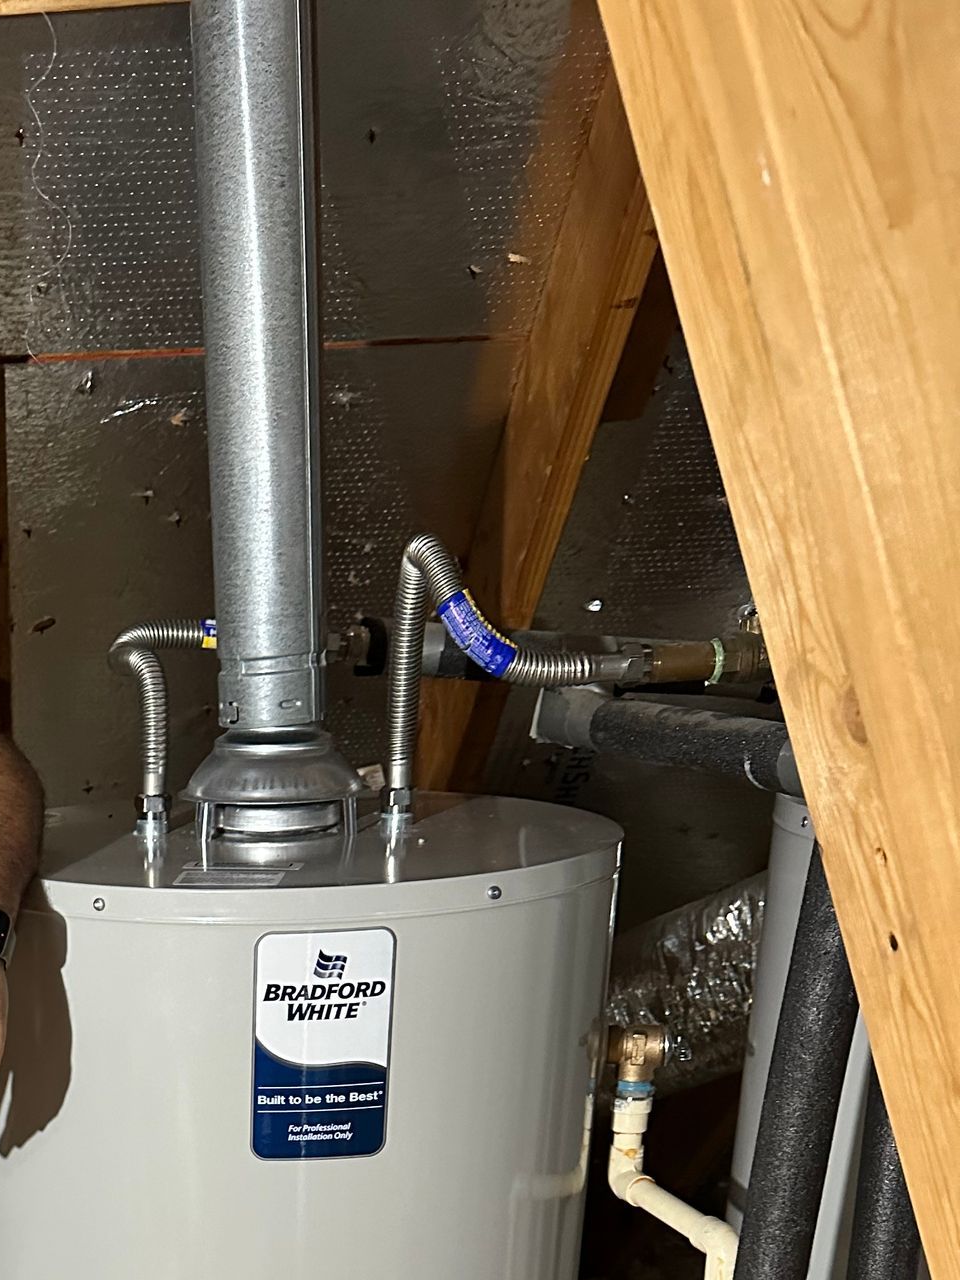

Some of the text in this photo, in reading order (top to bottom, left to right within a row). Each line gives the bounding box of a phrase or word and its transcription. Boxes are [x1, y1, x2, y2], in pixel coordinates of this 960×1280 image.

[263, 981, 386, 1001] BRADFORD
[287, 1002, 360, 1021] WHITE
[258, 1095, 285, 1104] Built
[289, 1096, 302, 1104] to
[305, 1095, 321, 1103] be
[326, 1094, 345, 1103] the
[303, 1123, 351, 1132] Professional
[288, 1131, 353, 1141] Installation Only
